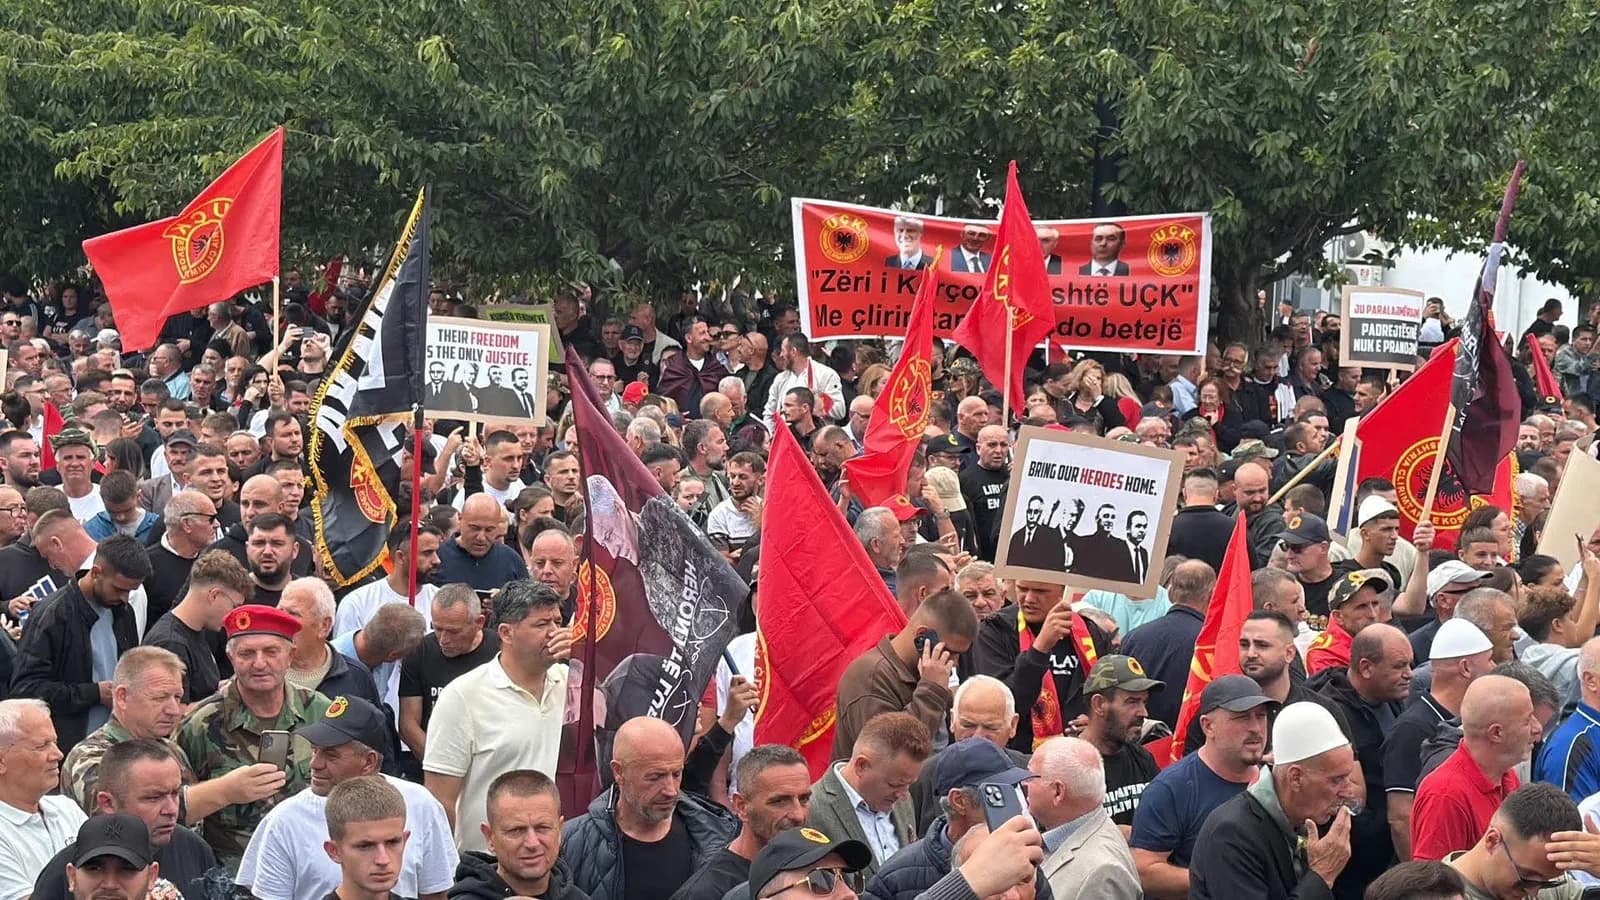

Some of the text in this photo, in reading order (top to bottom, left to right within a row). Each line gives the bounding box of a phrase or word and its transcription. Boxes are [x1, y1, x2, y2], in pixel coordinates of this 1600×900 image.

[812, 269, 871, 292] "Zëri
[881, 271, 888, 293] i
[1051, 282, 1109, 306] shtë
[1119, 283, 1193, 312] UÇK"
[438, 329, 520, 349] THEIR FREEDOM
[816, 303, 842, 327] Me
[1048, 316, 1091, 338] do
[1100, 317, 1183, 346] betejë
[436, 345, 456, 359] THE
[458, 347, 484, 362] ONLY
[485, 350, 533, 367] JUSTICE.
[1353, 338, 1375, 352] NUK
[1375, 339, 1382, 352] E
[1028, 461, 1158, 497] BRING OUR HEROES HOME.
